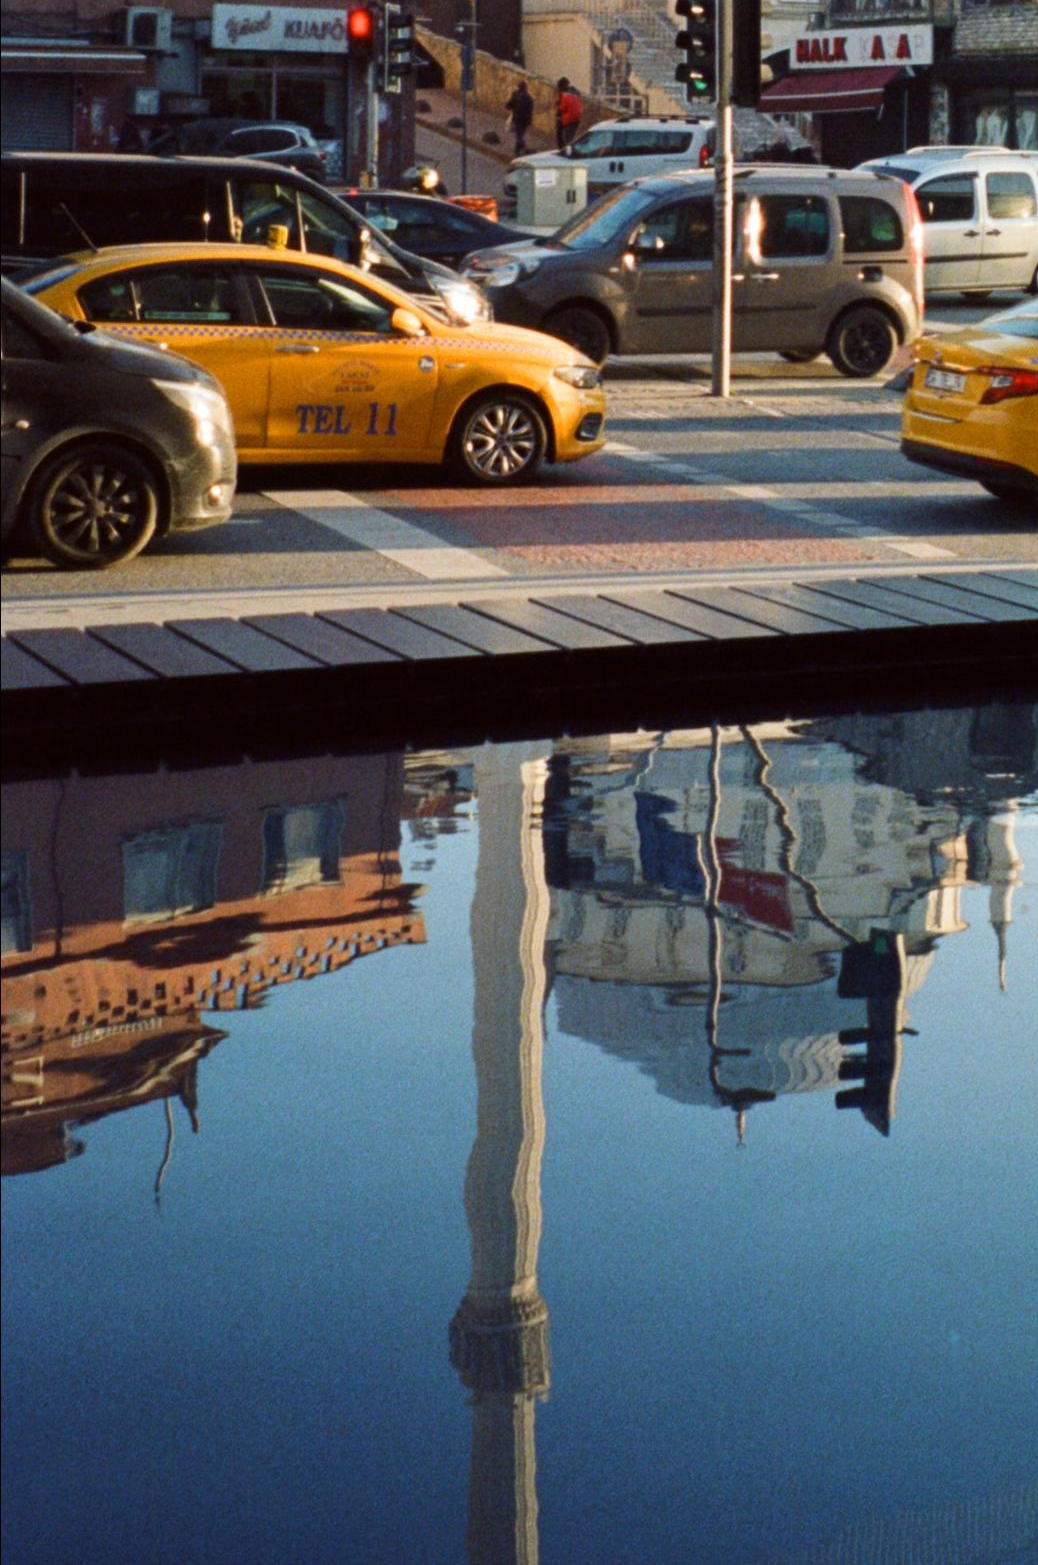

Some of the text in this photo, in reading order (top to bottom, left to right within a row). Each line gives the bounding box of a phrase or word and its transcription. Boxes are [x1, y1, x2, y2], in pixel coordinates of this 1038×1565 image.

[284, 17, 345, 40] KUAFÖ
[796, 36, 848, 63] HALK
[295, 402, 398, 436] TEL 11
